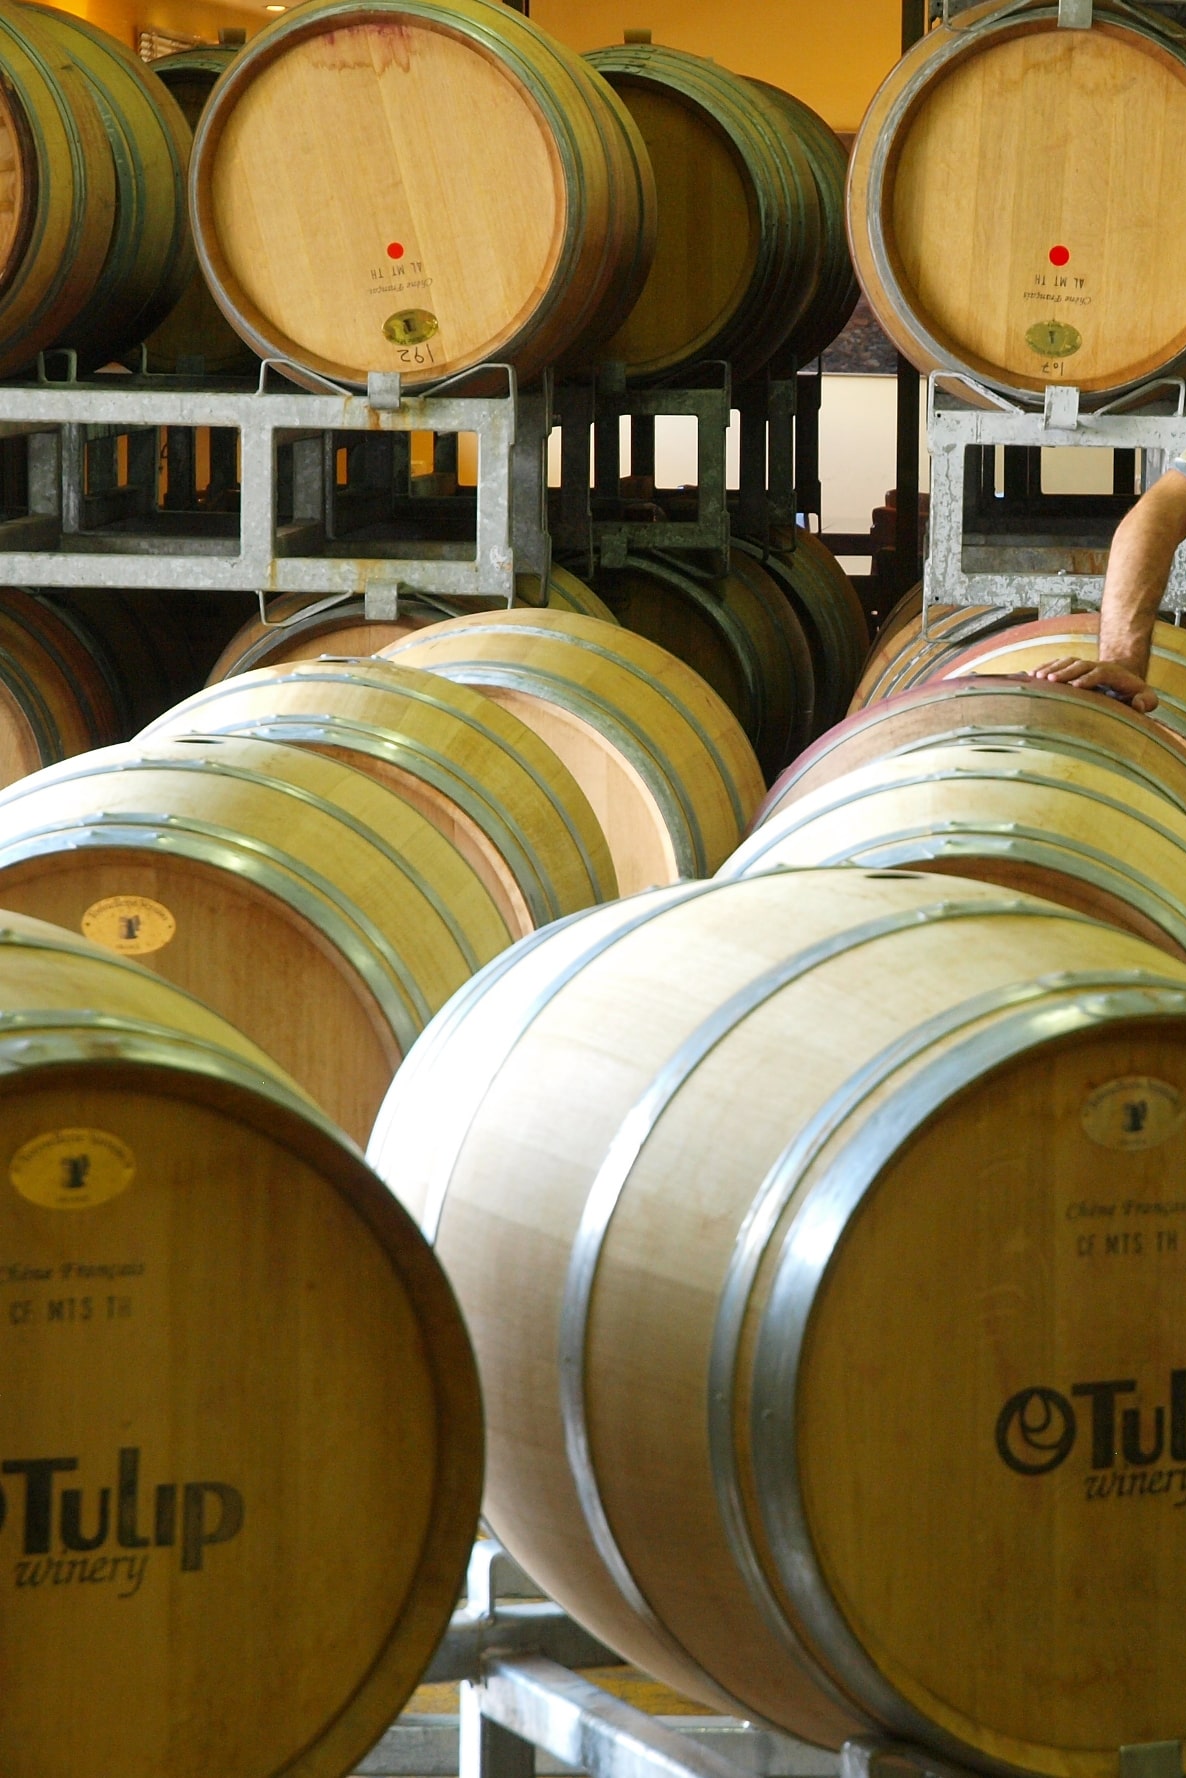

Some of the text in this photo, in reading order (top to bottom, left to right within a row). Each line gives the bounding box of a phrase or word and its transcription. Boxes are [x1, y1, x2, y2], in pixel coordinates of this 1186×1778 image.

[370, 268, 384, 280] TH
[391, 265, 405, 277] MT
[1034, 274, 1085, 289] AL MT TH
[396, 344, 434, 364] 192
[2, 1446, 246, 1573] Tulip
[14, 1554, 150, 1599] winery
